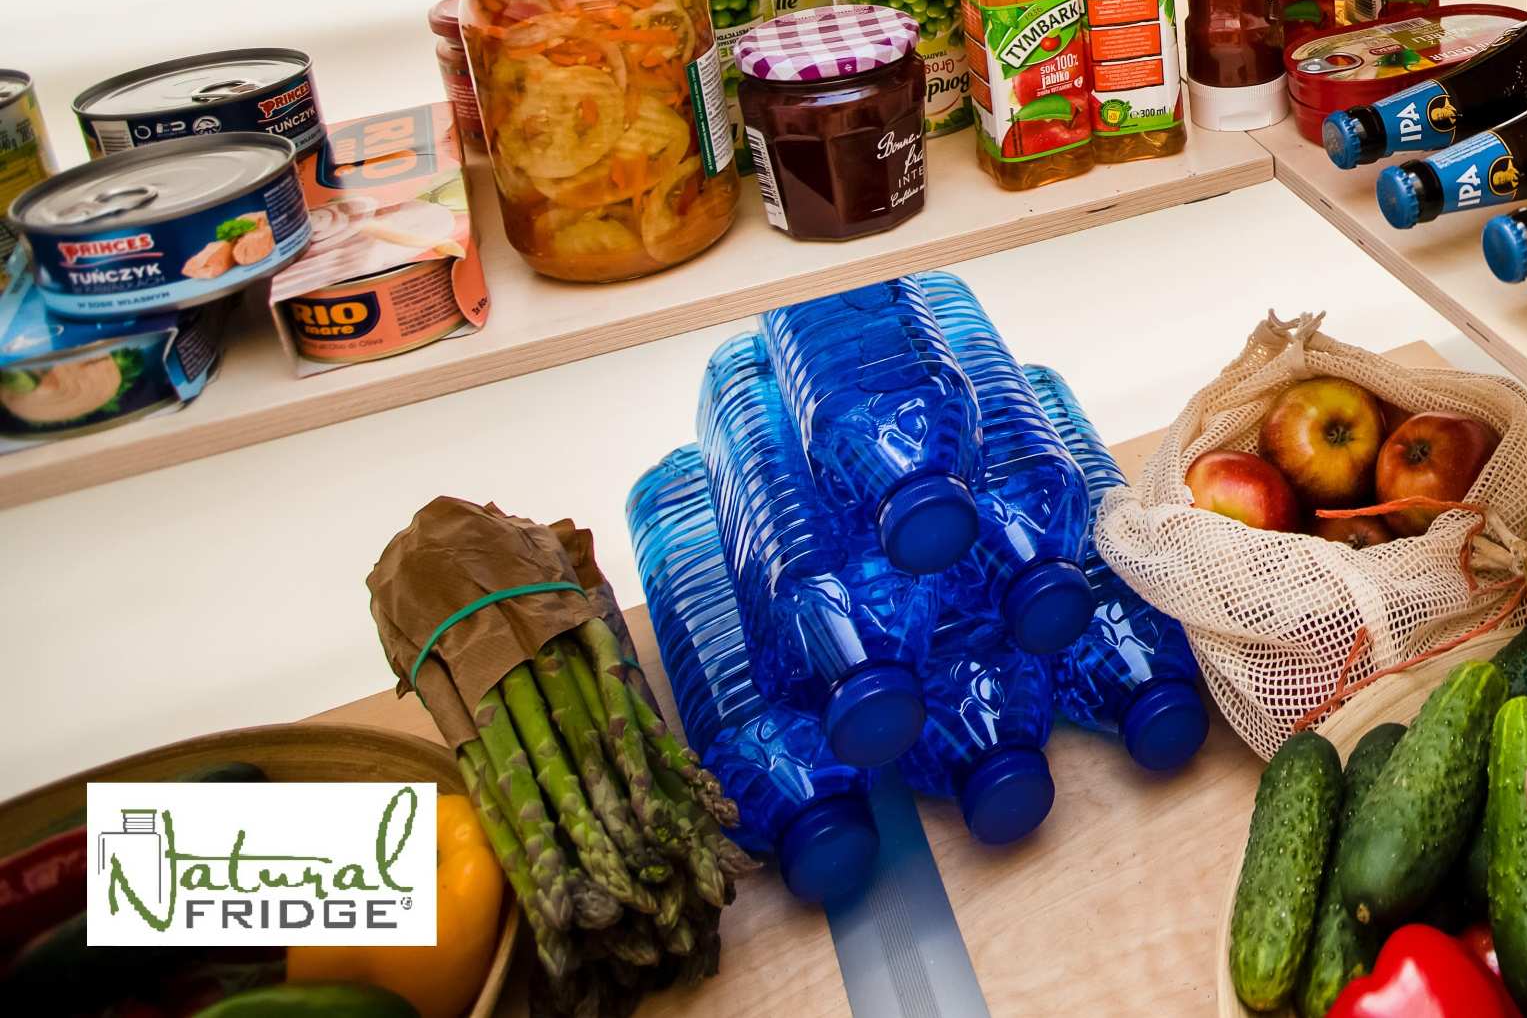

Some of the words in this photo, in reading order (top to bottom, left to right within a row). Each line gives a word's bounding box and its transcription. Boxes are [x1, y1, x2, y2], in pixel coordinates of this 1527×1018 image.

[1005, 0, 1079, 61] TYMBARK
[1055, 53, 1079, 71] 100%
[257, 80, 312, 118] PRINCES
[926, 71, 970, 103] Bond
[265, 106, 318, 135] TUŃCZYK
[1140, 108, 1155, 119] 300
[1396, 101, 1422, 143] IPA
[904, 144, 924, 175] fra
[898, 165, 925, 189] INTE
[1456, 164, 1482, 208] IPA
[57, 233, 155, 265] PRINCES
[68, 262, 162, 286] TUŃCZYK
[293, 300, 369, 326] RIO
